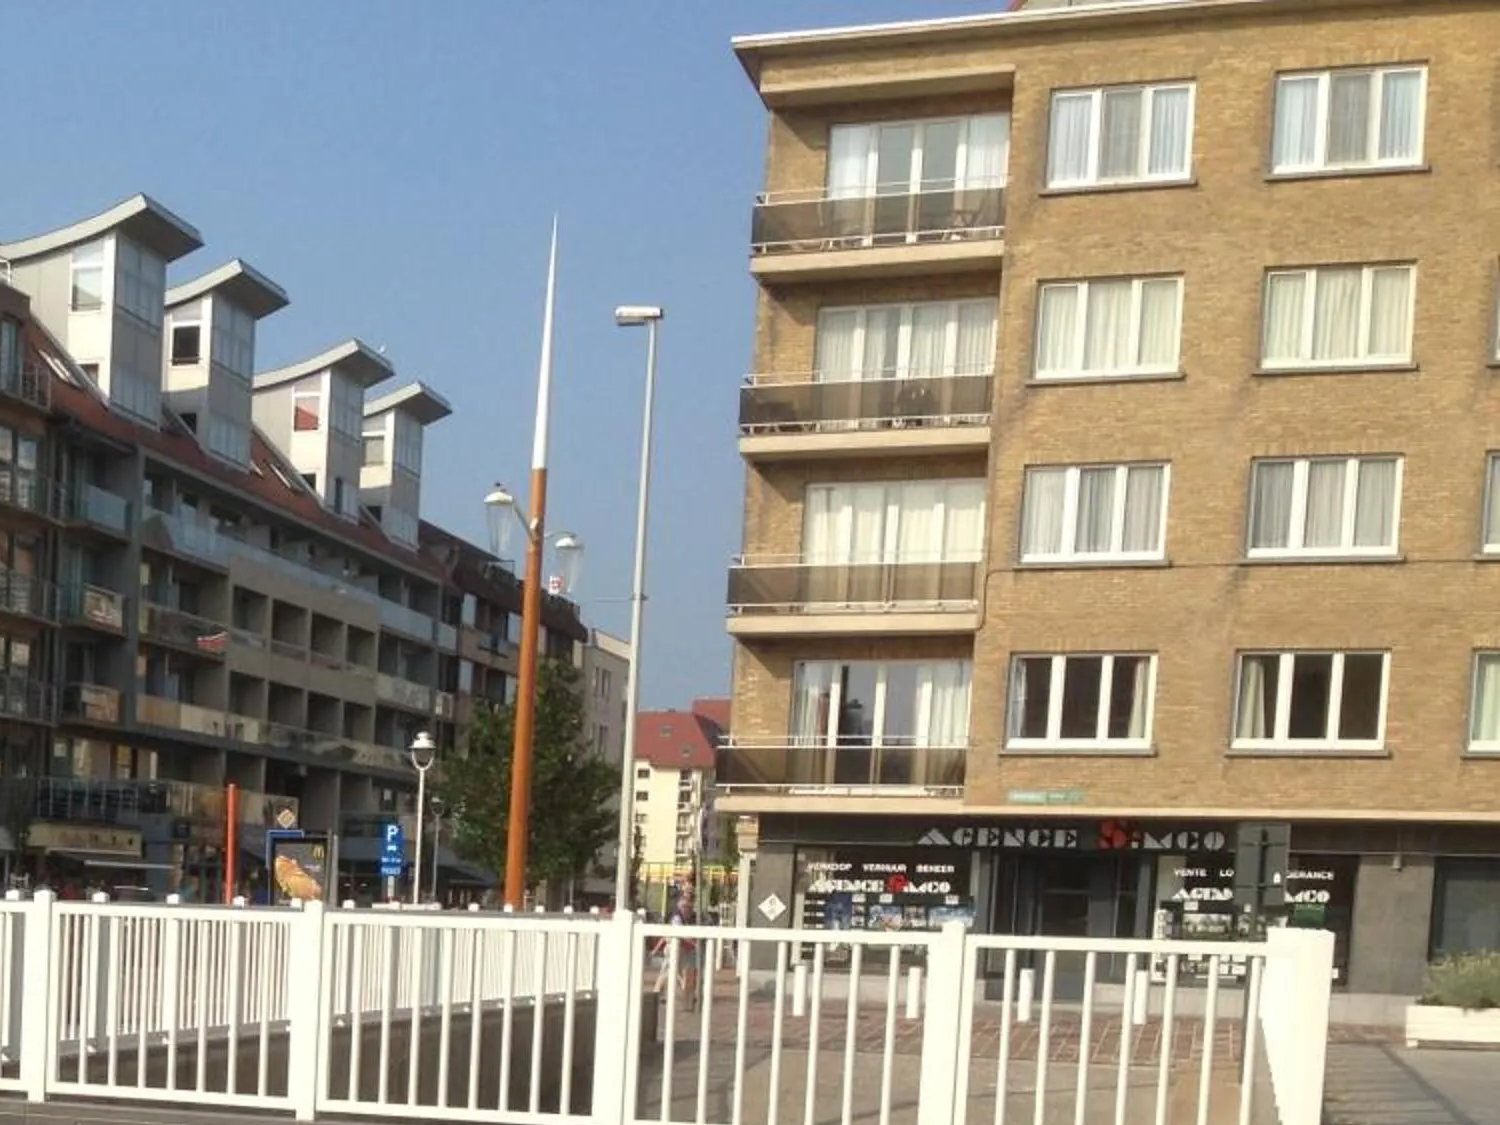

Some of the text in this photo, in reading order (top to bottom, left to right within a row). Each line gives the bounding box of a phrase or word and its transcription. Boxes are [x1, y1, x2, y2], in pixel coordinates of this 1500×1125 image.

[387, 825, 398, 842] P
[916, 826, 1078, 848] AGENCE
[808, 879, 885, 893] AGENCE
